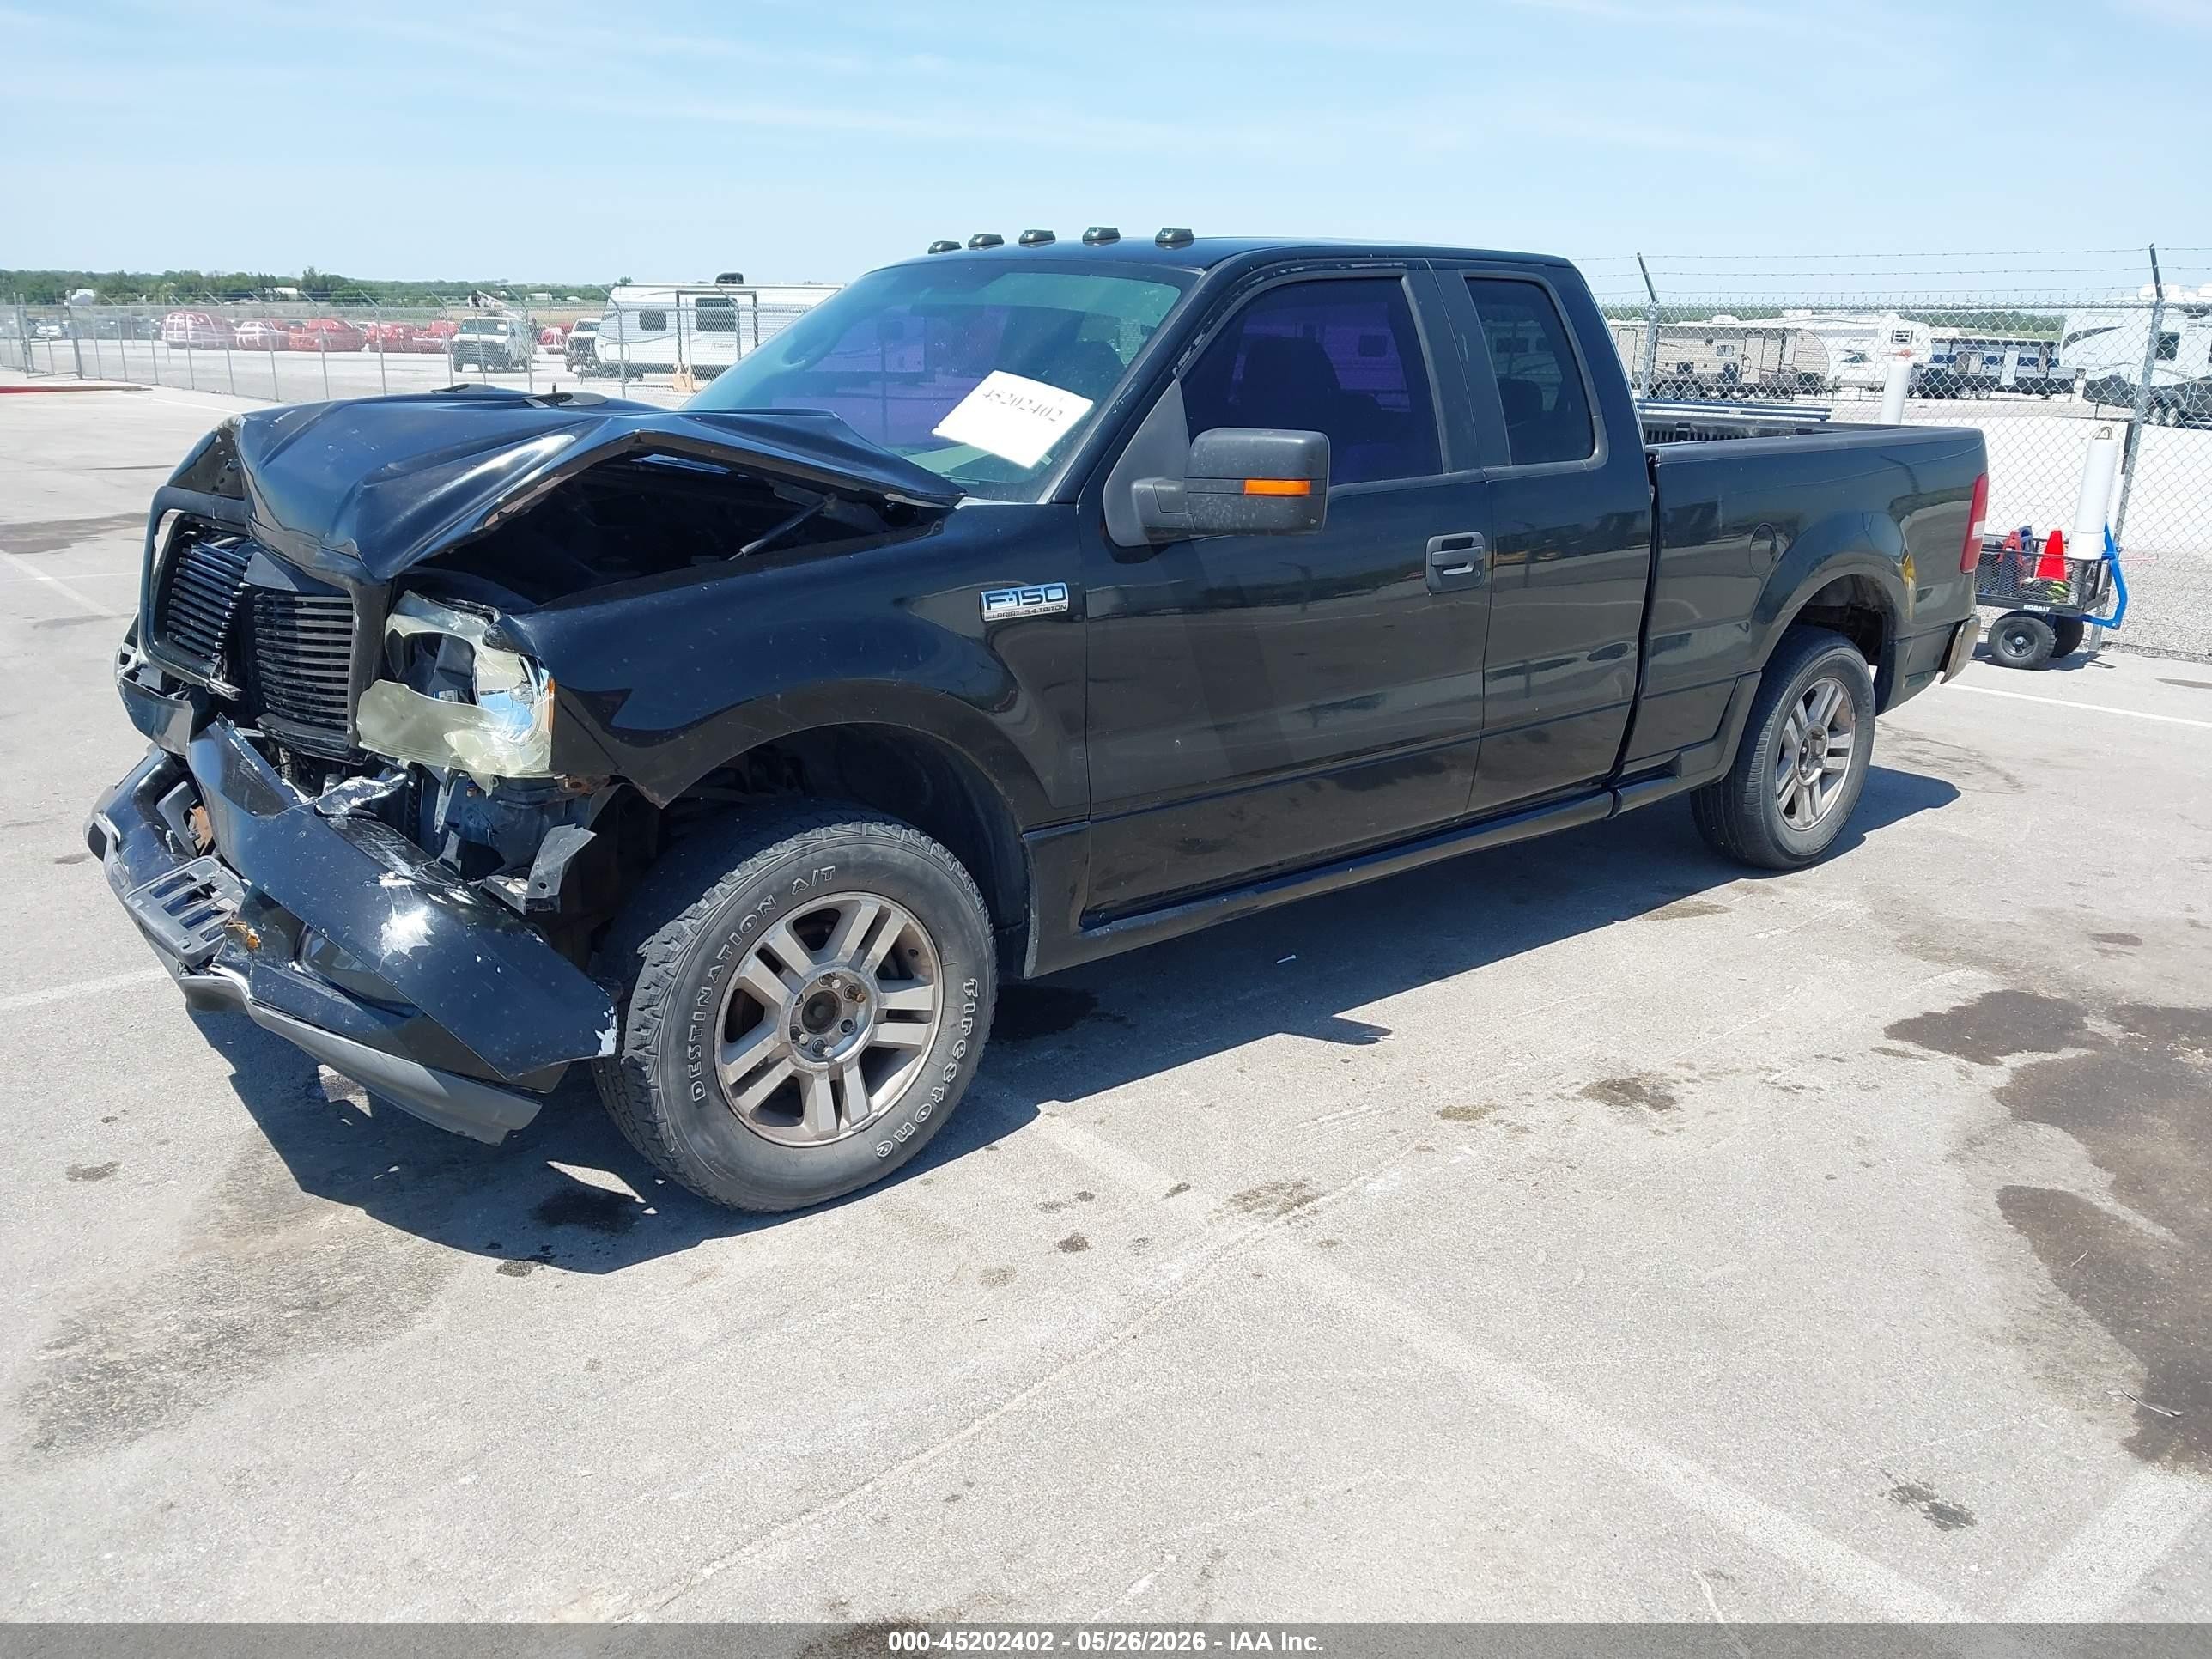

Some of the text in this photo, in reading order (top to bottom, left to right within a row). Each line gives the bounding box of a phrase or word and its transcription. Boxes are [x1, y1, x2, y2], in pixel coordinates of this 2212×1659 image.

[982, 389, 1064, 422] 45202402
[1036, 604, 1066, 613] TRITON
[2023, 604, 2051, 612] KOBALT
[687, 865, 836, 1103] DESTINATION A/T
[876, 977, 979, 1158] Firestone
